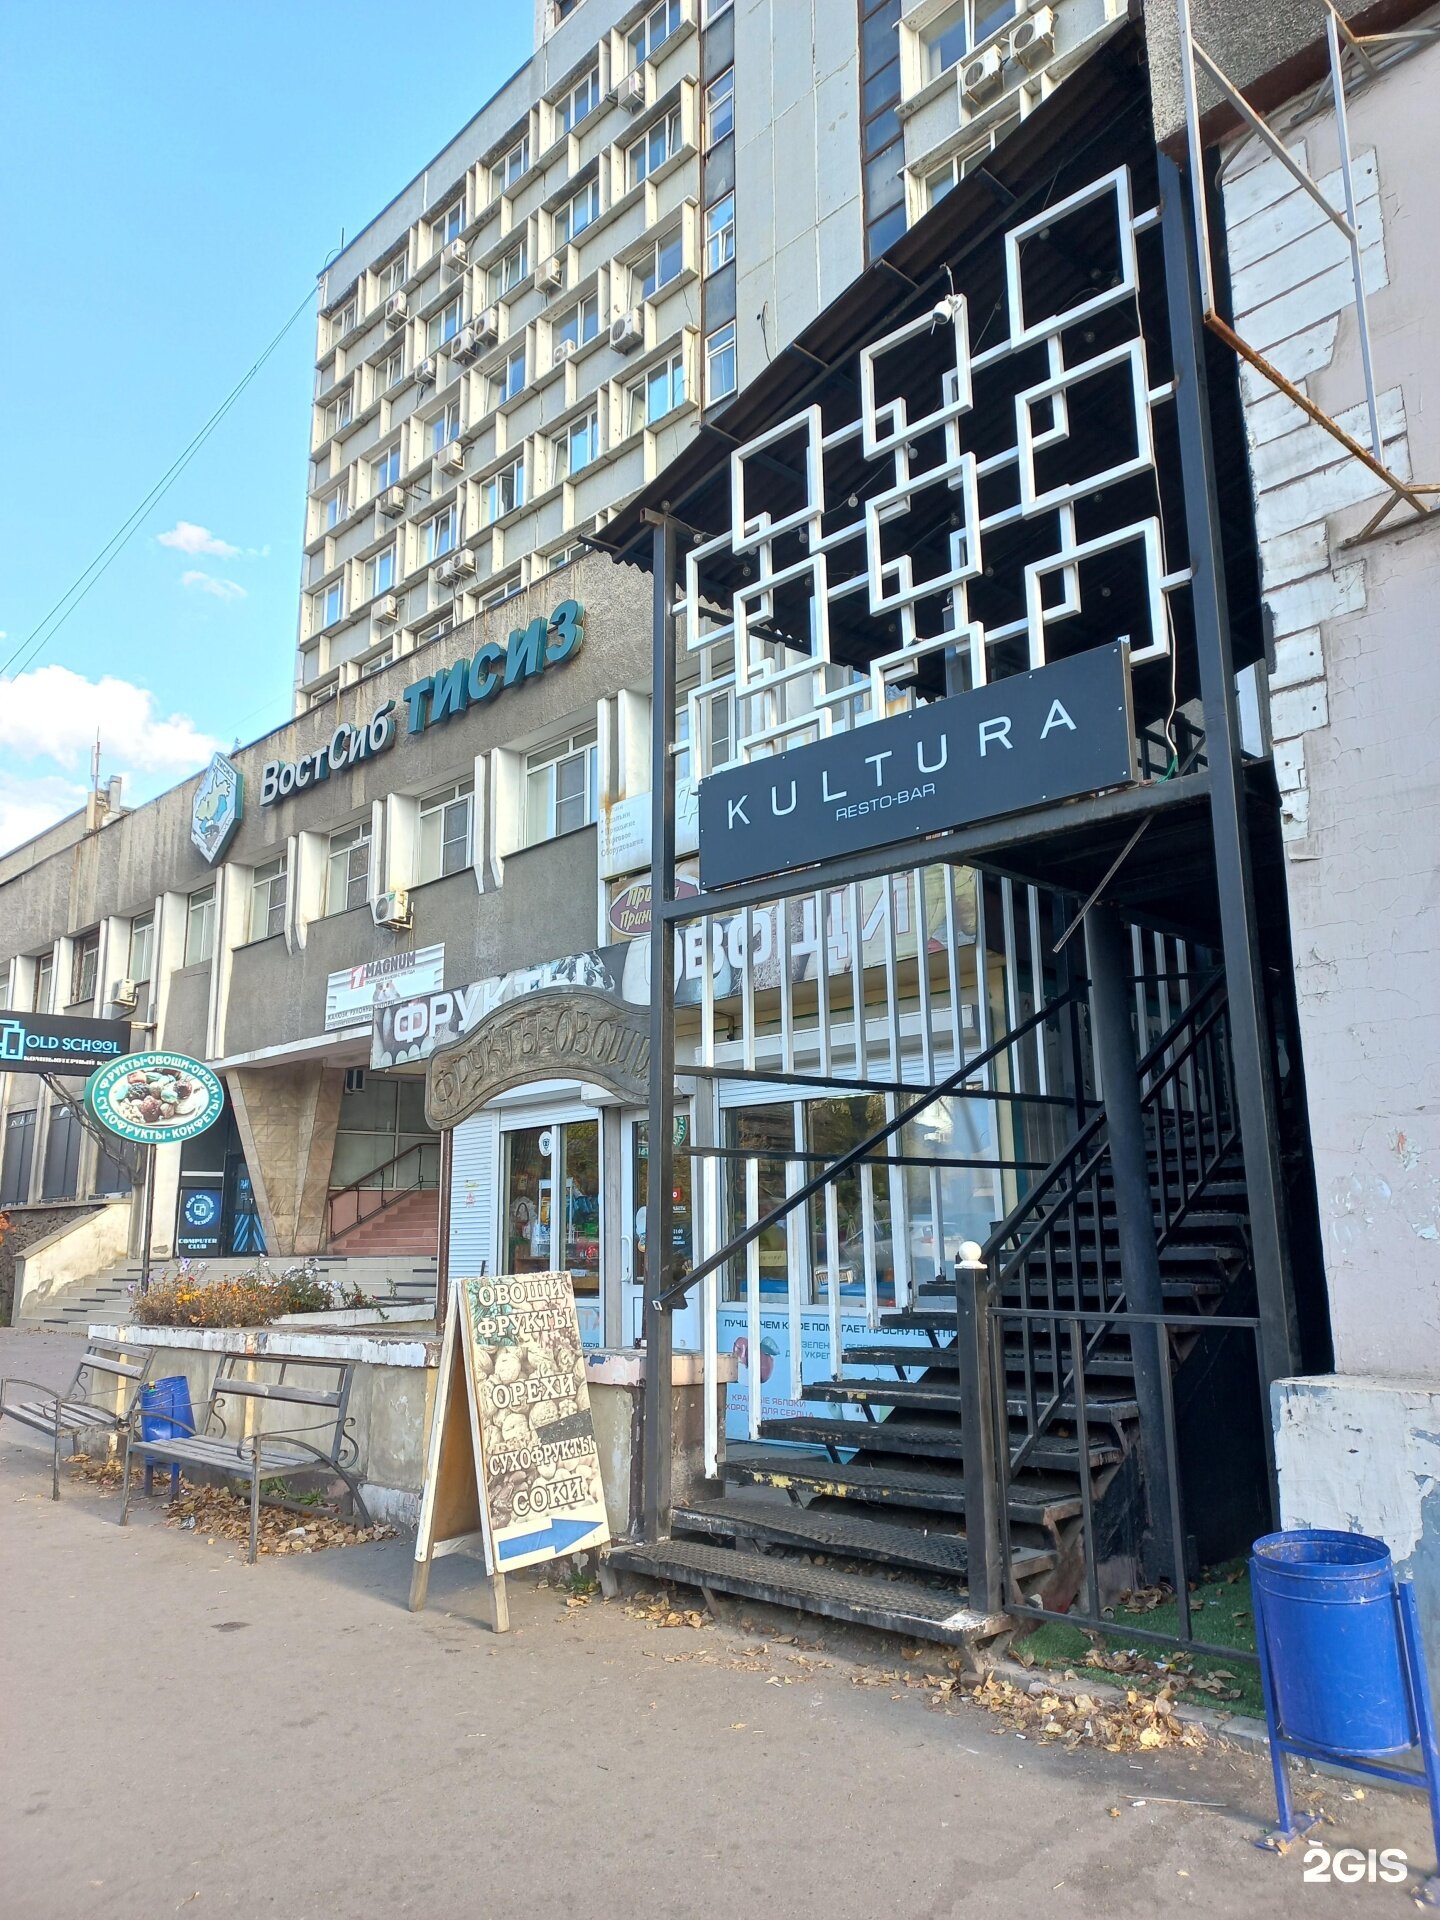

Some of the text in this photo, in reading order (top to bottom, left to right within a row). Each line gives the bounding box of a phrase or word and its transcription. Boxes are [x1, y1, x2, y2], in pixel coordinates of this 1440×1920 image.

[260, 599, 584, 807] ВостСиб ТИСИЗ
[727, 699, 1077, 829] KULTURA
[836, 783, 936, 822] RESTO-BAR
[366, 951, 416, 979] MAGNUM
[26, 1034, 121, 1054] OLD SCHOOL
[478, 1278, 566, 1307] ОВОЩИ
[476, 1307, 574, 1339] ФРУКТЫ
[724, 1318, 751, 1329] ЛУЧШ
[491, 1372, 578, 1410] ОРЕХИ
[488, 1434, 596, 1477] СУХОФРУКТЫ
[511, 1475, 586, 1518] СОКИ
